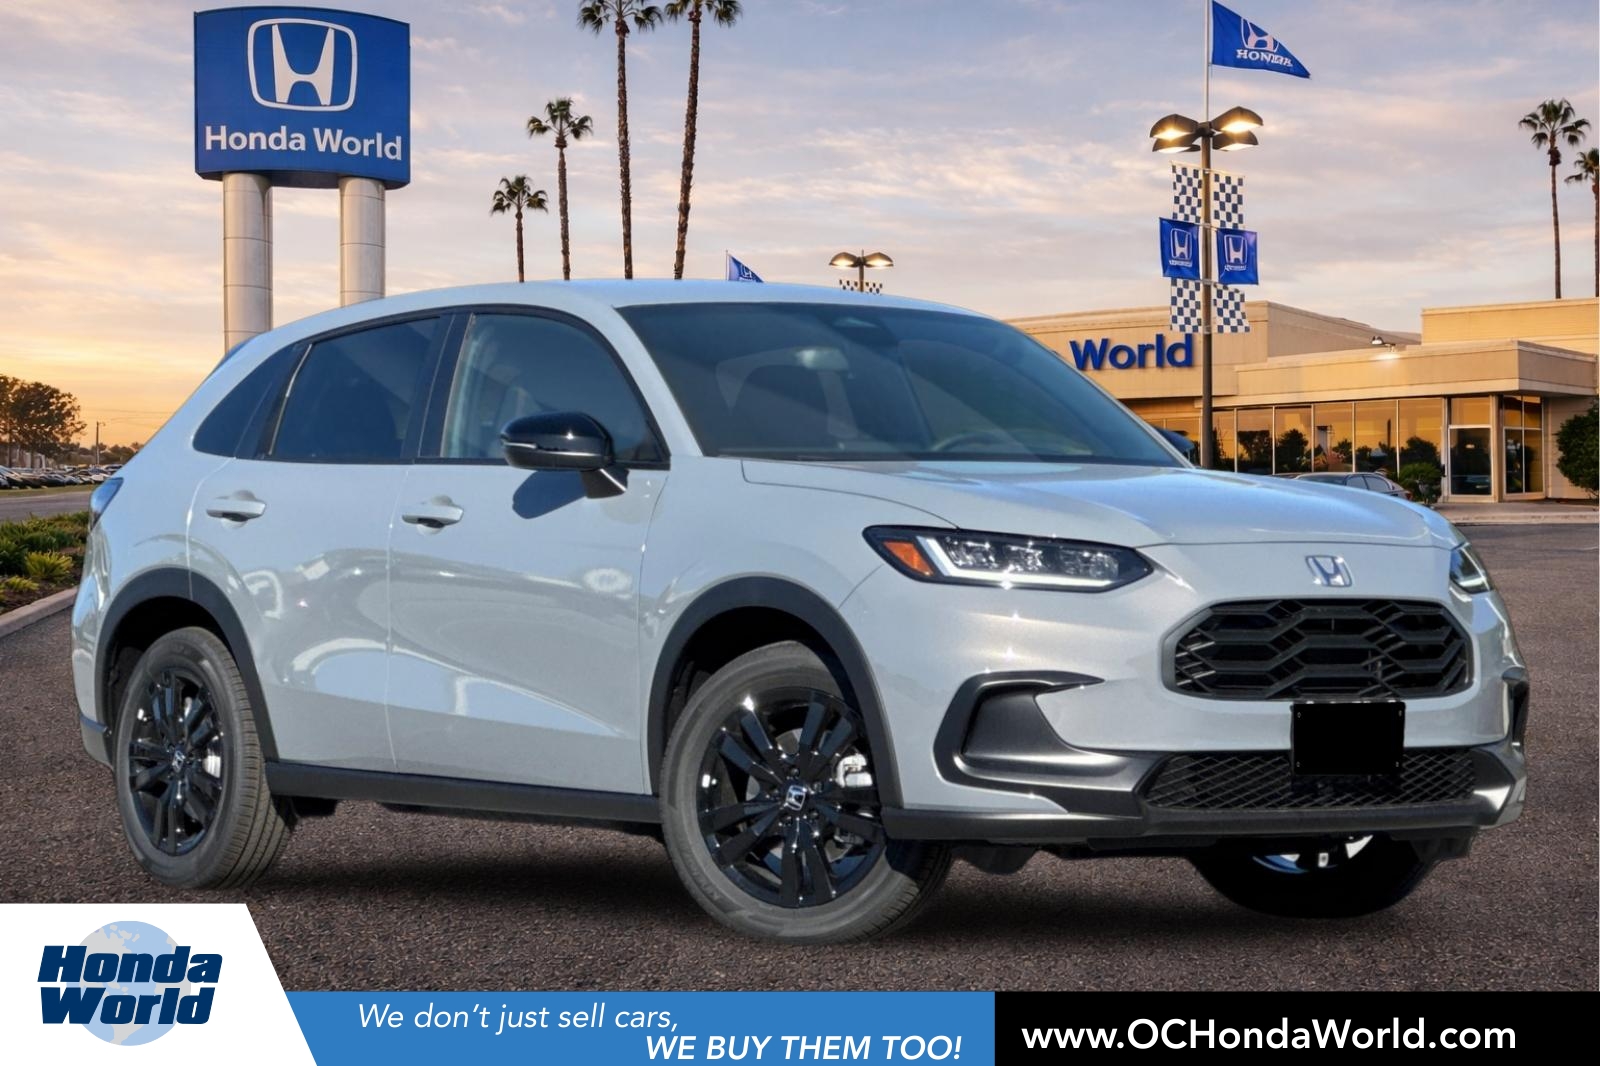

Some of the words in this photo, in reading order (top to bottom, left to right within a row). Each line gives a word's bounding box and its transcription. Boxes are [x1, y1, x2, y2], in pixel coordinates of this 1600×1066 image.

[205, 125, 306, 151] Honda
[313, 128, 402, 160] World
[1069, 333, 1194, 371] World
